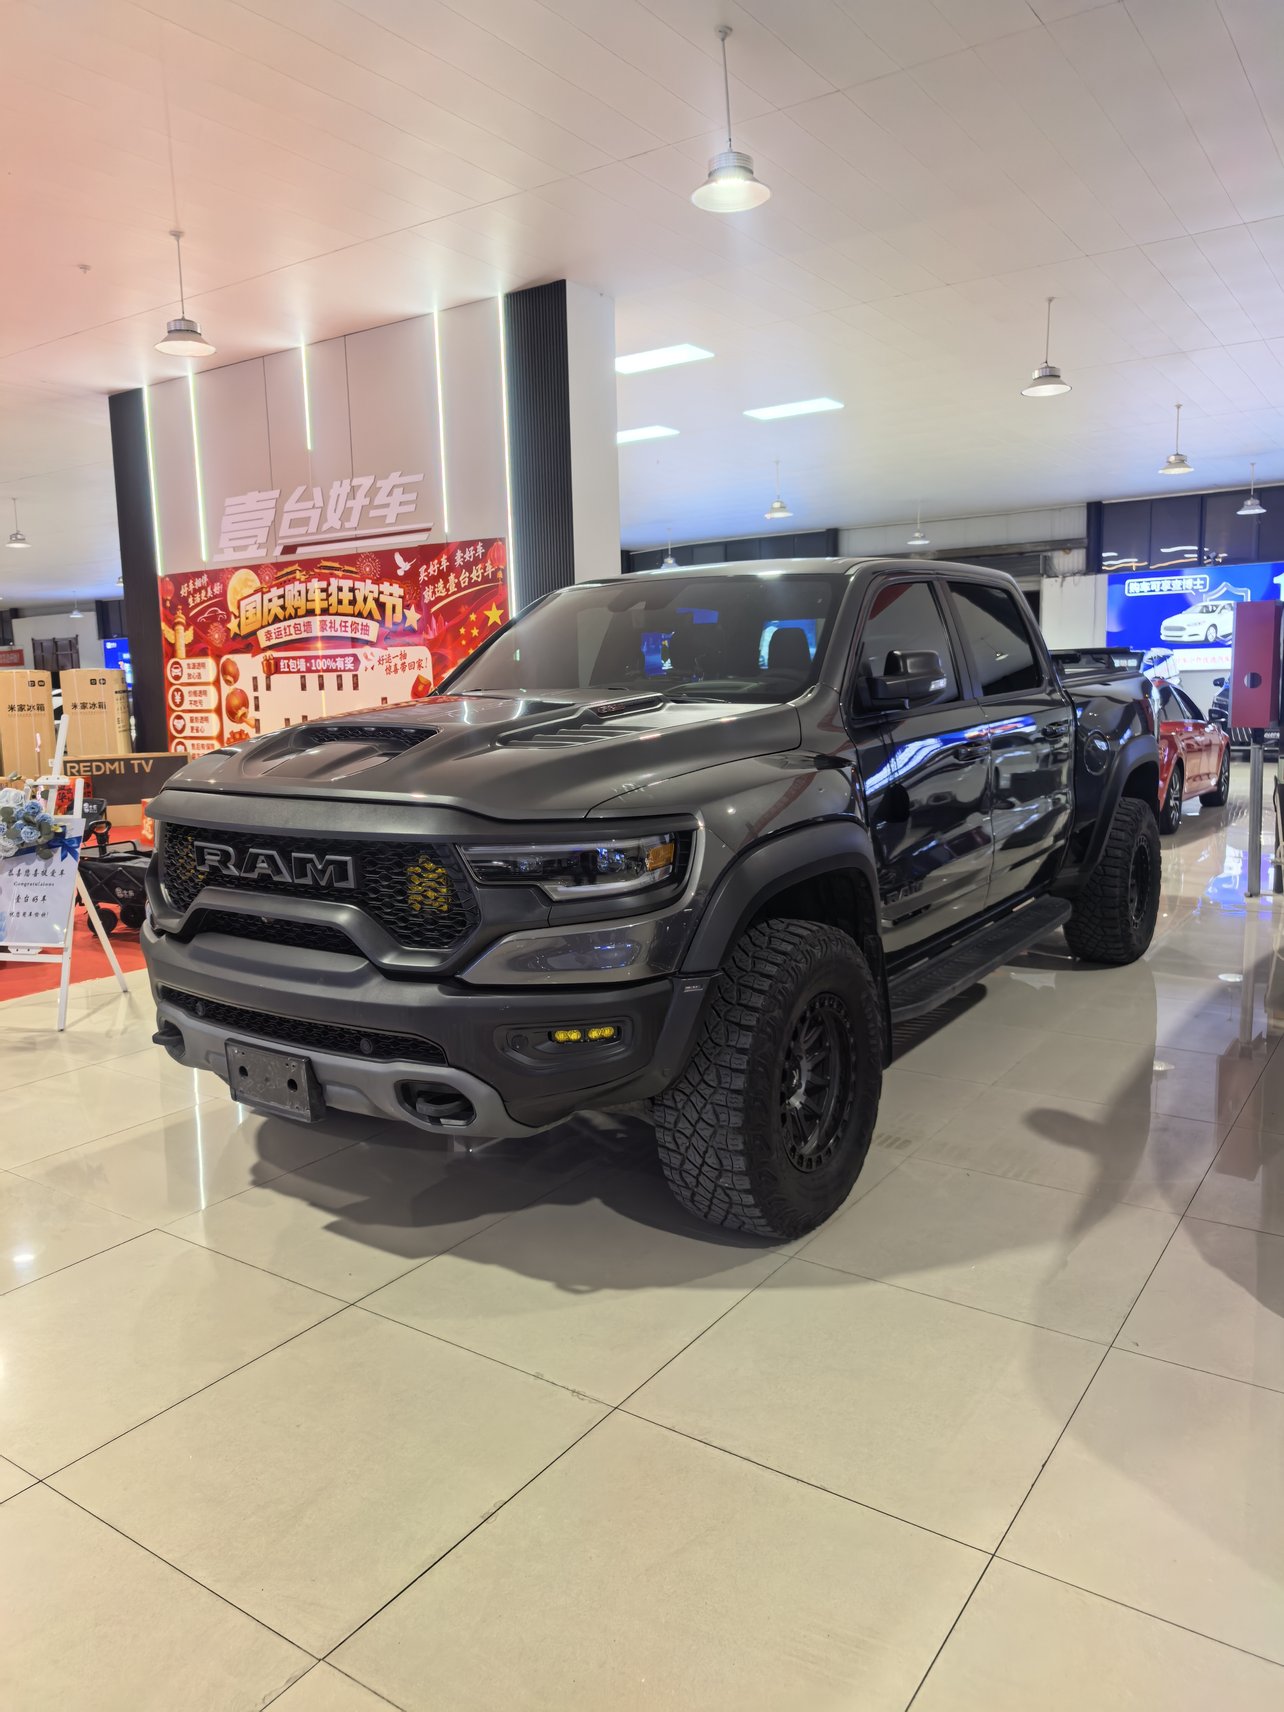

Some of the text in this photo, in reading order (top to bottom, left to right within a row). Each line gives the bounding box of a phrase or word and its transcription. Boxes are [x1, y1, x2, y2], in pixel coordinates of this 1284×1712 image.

[213, 471, 425, 562] 壹台好车
[418, 541, 486, 584] 买好车 卖好车
[422, 559, 498, 604] 就选壹台好车
[239, 577, 404, 636] 国庆购车狂欢节
[263, 618, 371, 642] 幸运红包墙 豪礼任你抽
[7, 703, 45, 713] 米家冰箱
[71, 701, 107, 711] 米家冰箱
[66, 759, 154, 776] REDMI TV
[194, 841, 357, 889] RAM
